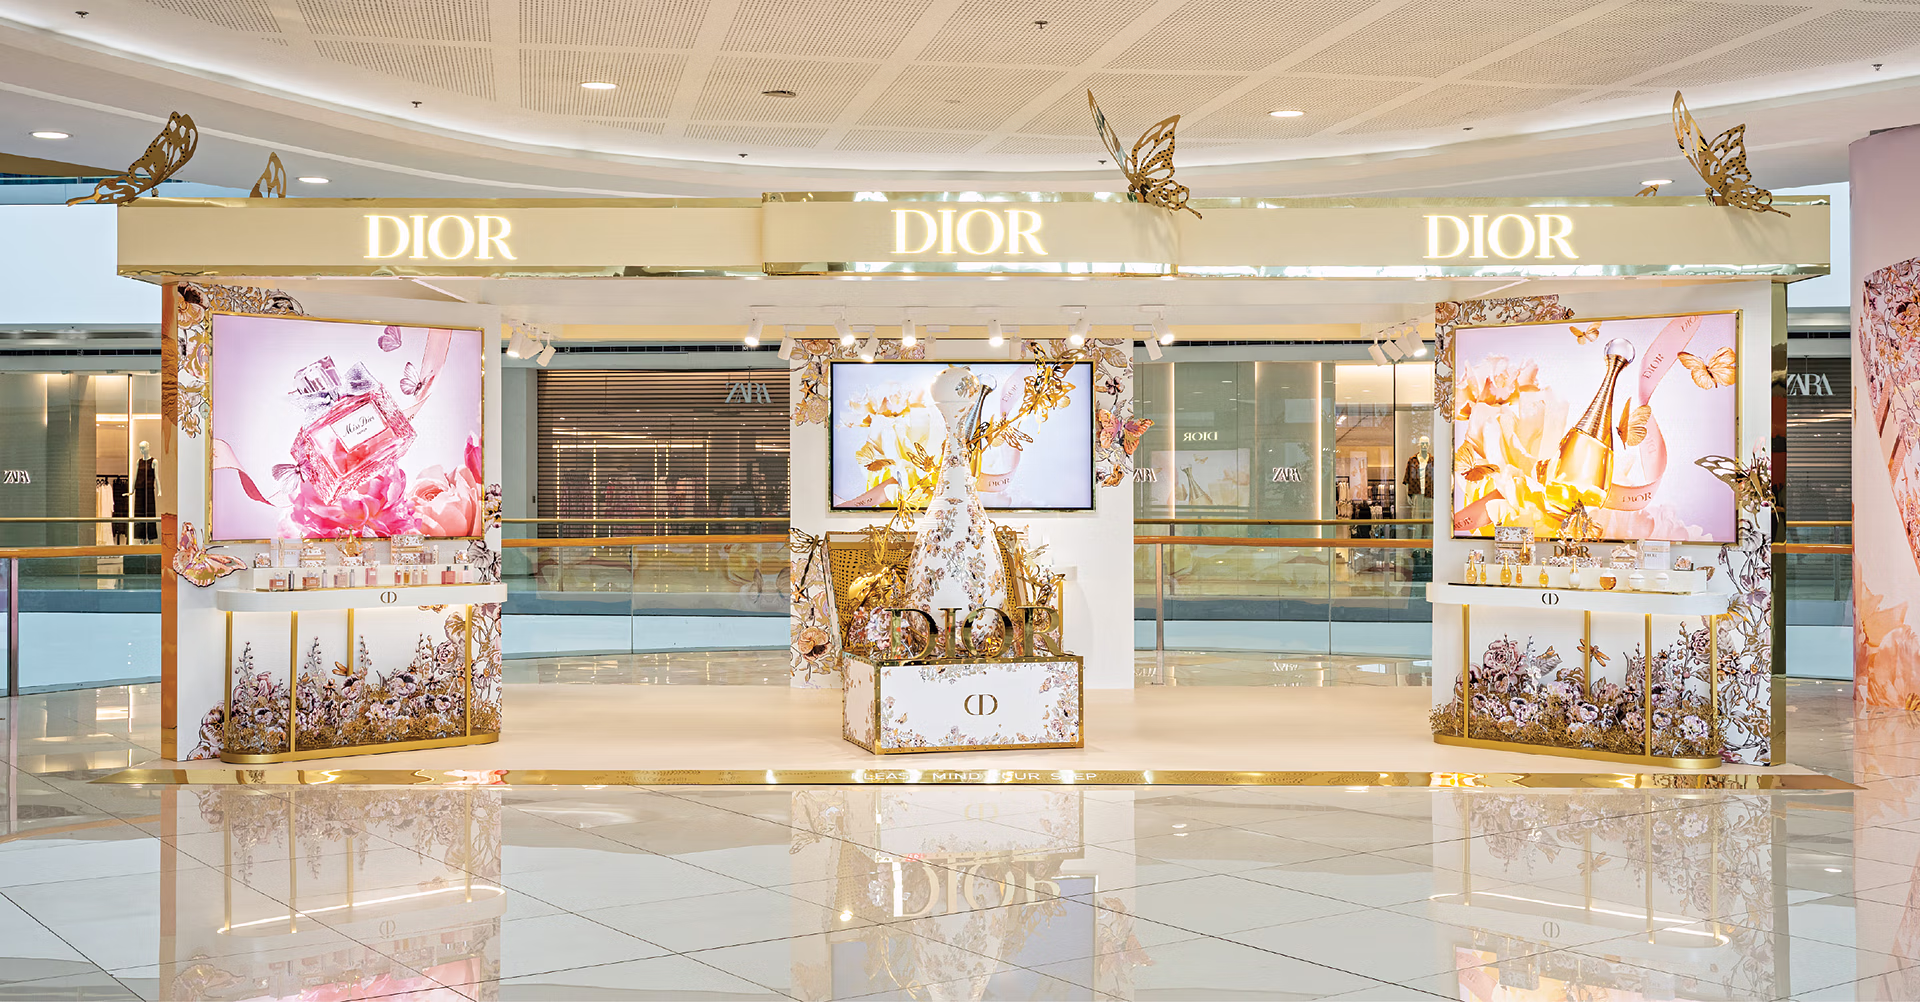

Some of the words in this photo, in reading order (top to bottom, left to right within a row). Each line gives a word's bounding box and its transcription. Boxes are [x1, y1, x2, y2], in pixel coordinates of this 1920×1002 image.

[363, 214, 518, 260] DIOR
[890, 208, 1049, 256] DIOR
[1422, 213, 1580, 259] DIOR
[1642, 353, 1665, 379] DIOR
[724, 382, 773, 404] ZARA
[342, 422, 360, 438] Miss
[359, 415, 375, 428] Dior
[3, 469, 31, 484] ZARA
[1272, 467, 1302, 482] ZARA
[1622, 491, 1652, 503] DIOR
[884, 606, 1067, 661] DIOR
[851, 772, 919, 781] LEAS
[932, 772, 980, 781] MIND
[1050, 772, 1097, 781] SEP
